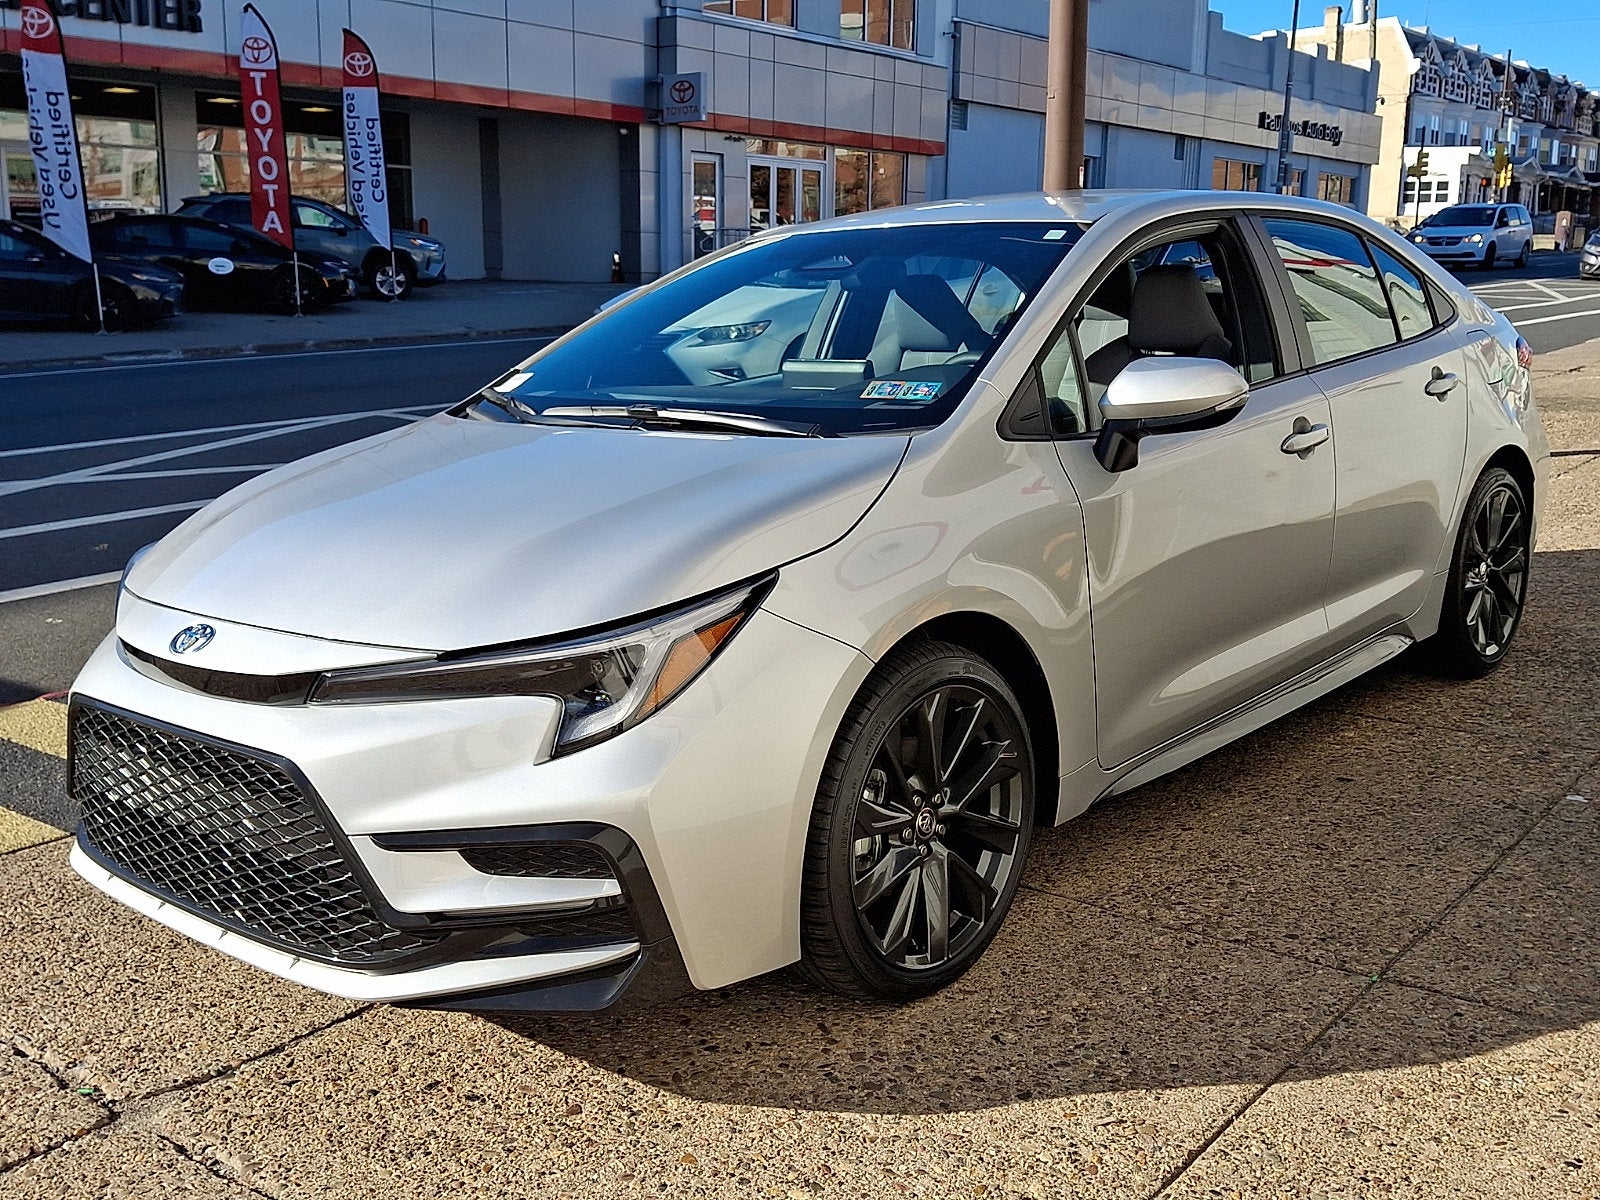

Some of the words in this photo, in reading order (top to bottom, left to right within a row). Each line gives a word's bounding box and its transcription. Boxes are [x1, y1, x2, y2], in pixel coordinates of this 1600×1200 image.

[665, 106, 699, 115] TOYOTA
[1303, 120, 1324, 139] Auto
[1325, 124, 1343, 146] Body
[250, 72, 284, 234] TOYOTA
